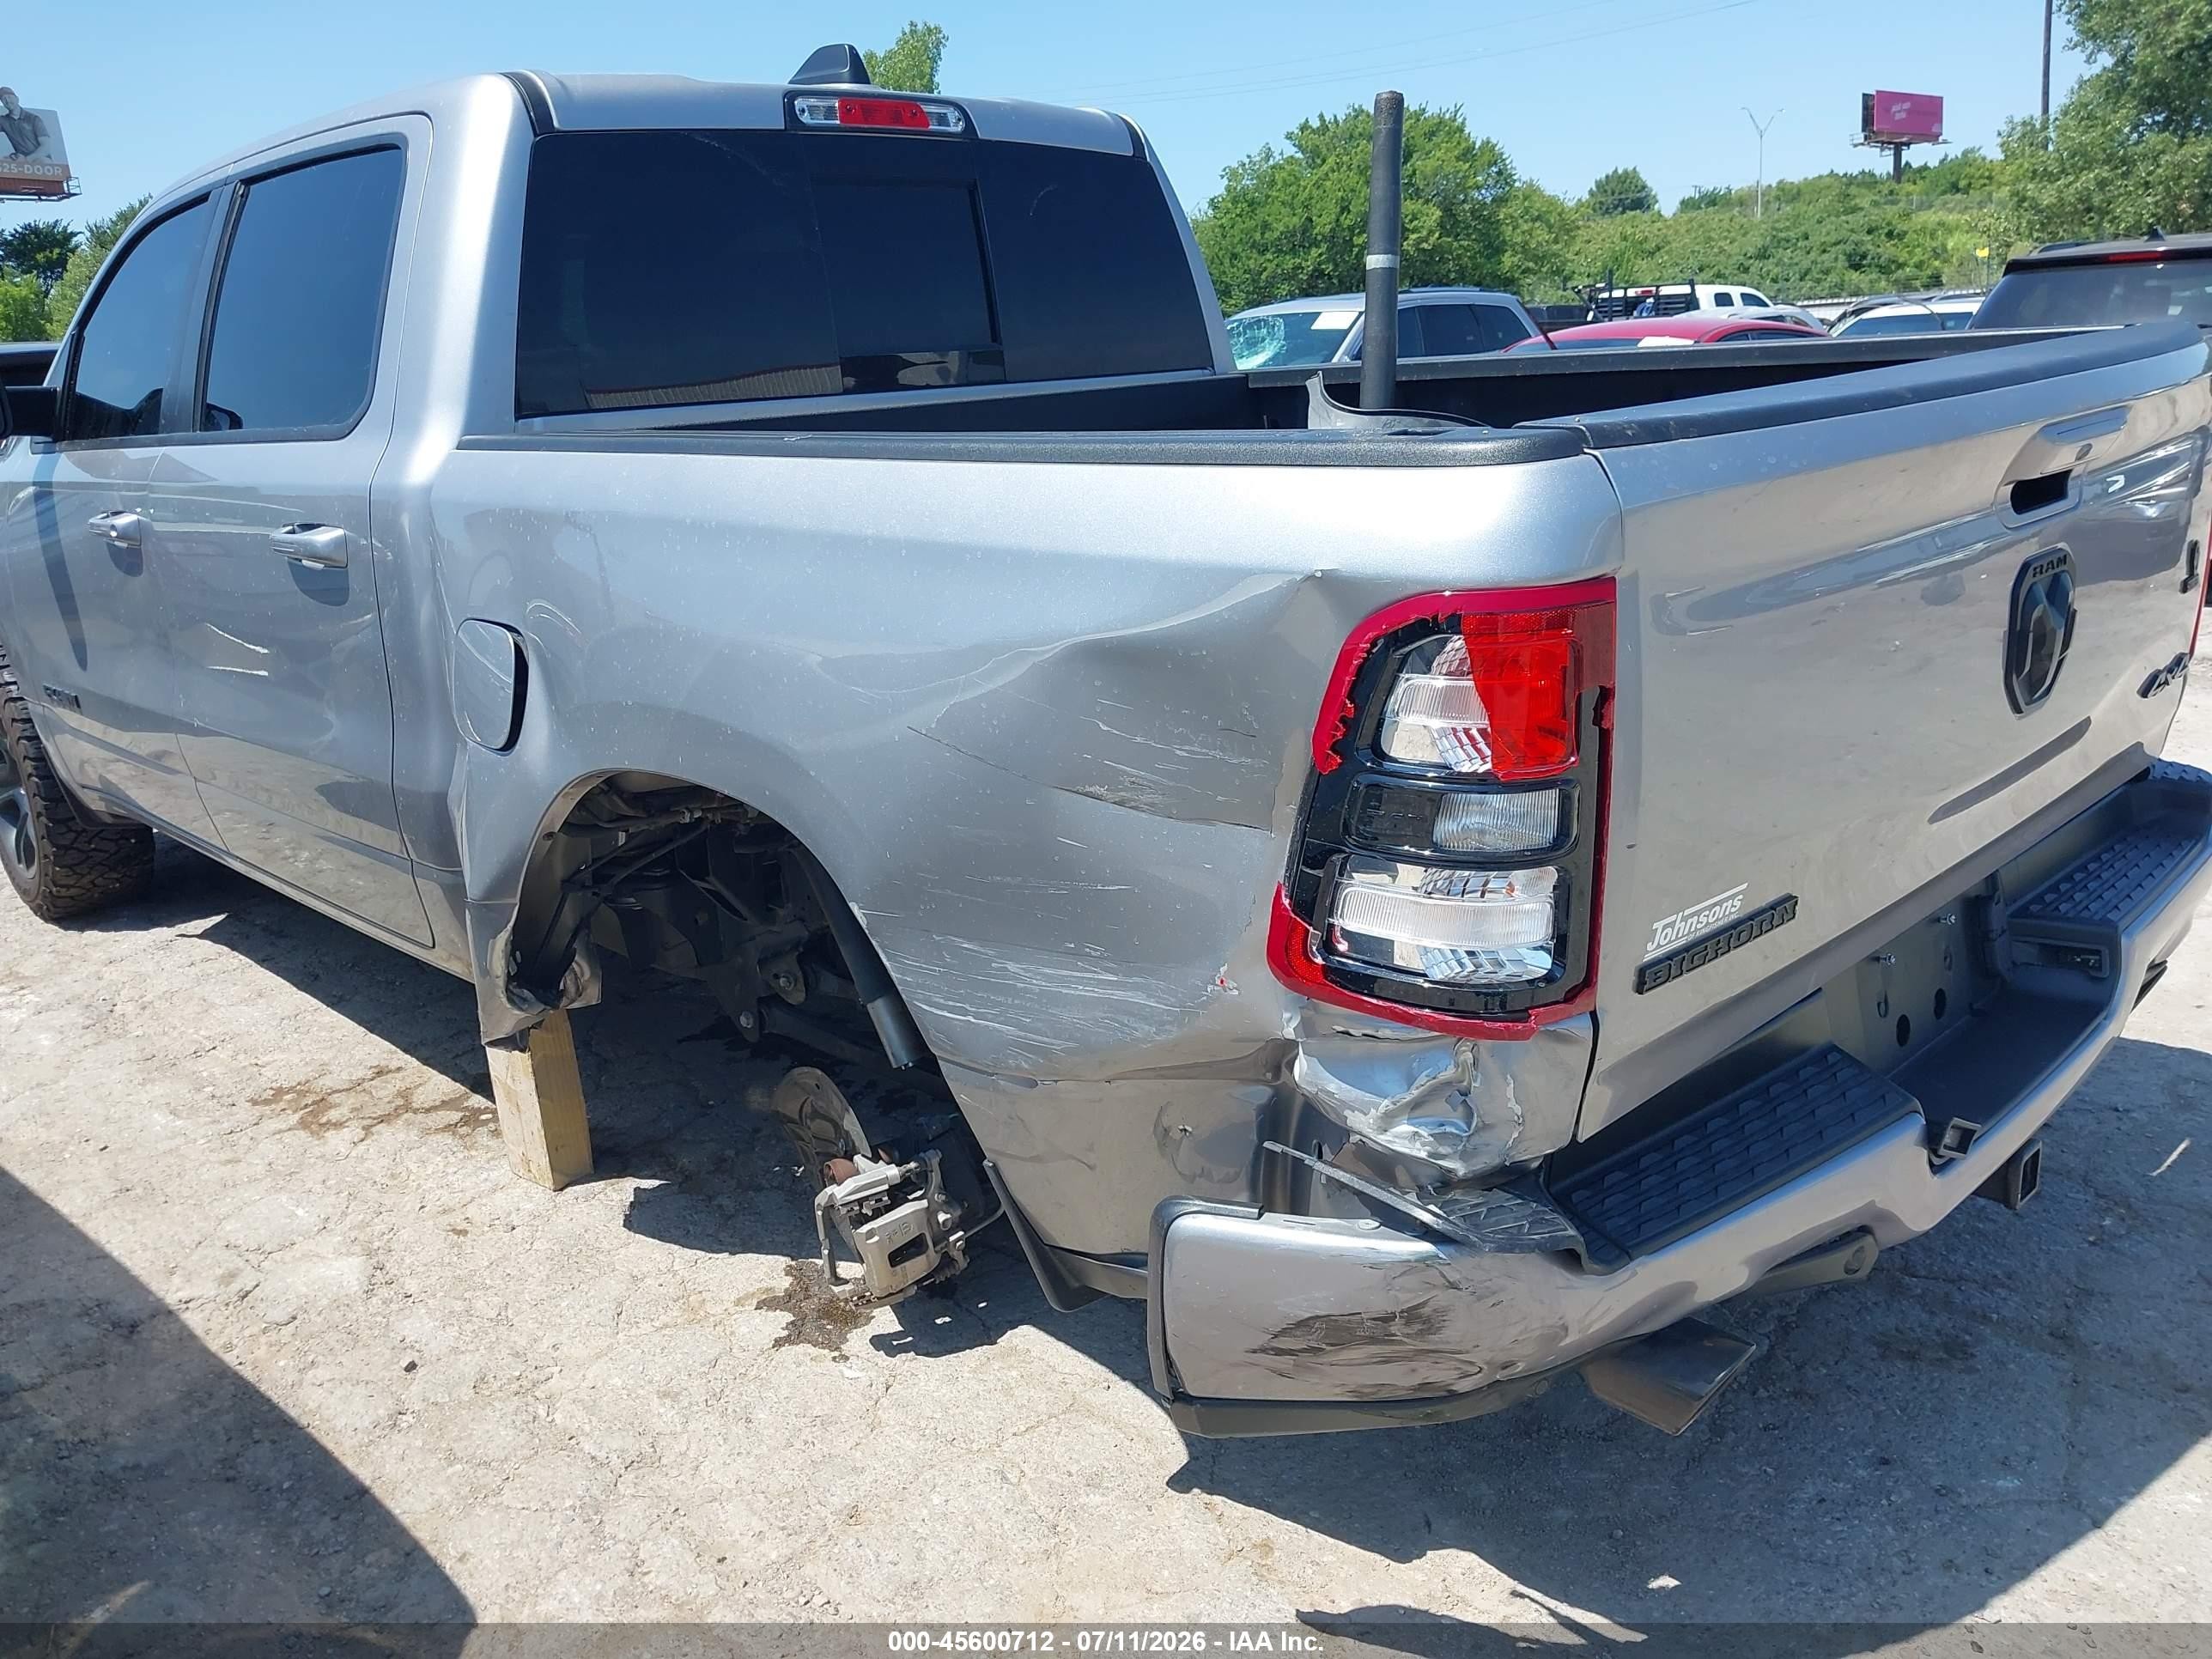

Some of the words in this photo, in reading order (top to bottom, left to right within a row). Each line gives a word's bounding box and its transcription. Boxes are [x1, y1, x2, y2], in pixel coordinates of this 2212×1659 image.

[2032, 554, 2068, 578] RAM
[1642, 896, 1800, 993] BIGHORN
[1646, 894, 1744, 951] Johnsons
